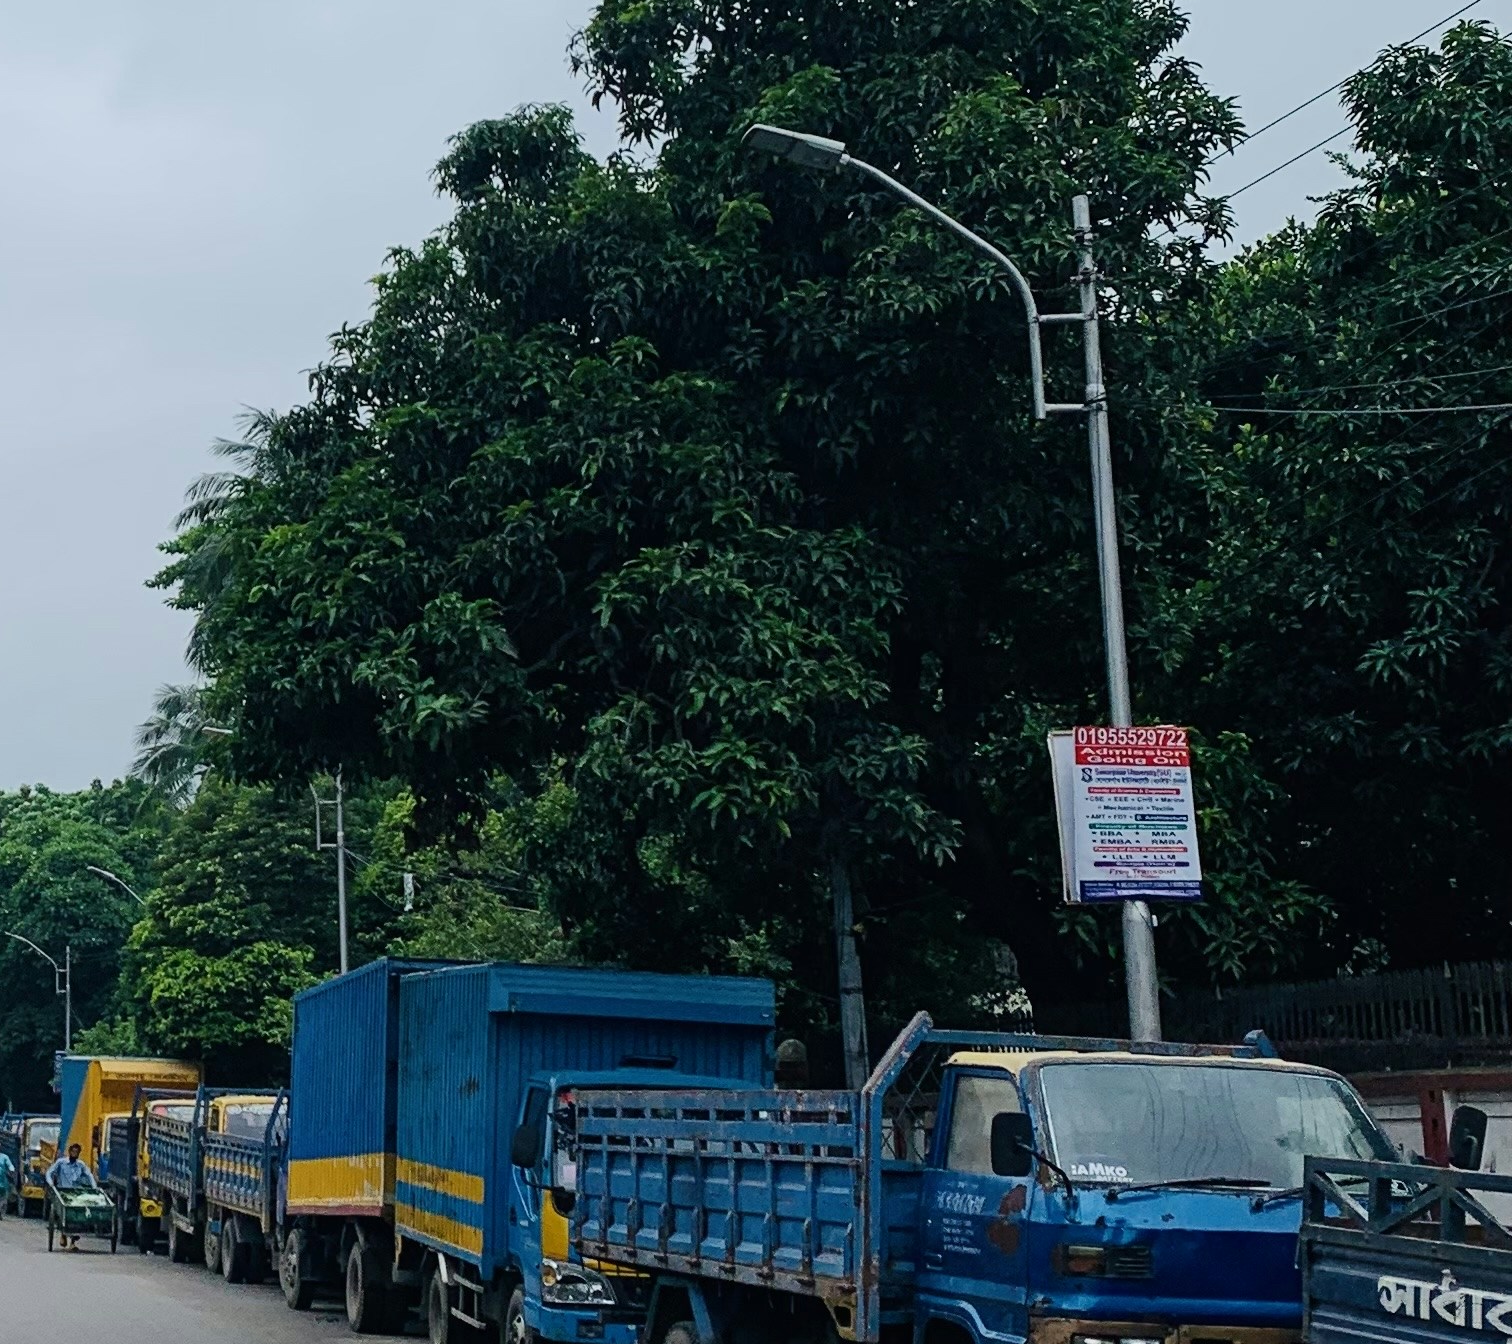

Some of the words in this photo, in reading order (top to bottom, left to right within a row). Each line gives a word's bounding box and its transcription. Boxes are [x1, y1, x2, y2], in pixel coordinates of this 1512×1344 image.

[1078, 728, 1187, 746] 01955529722
[1081, 747, 1187, 756] Admission
[1088, 756, 1146, 765] Going
